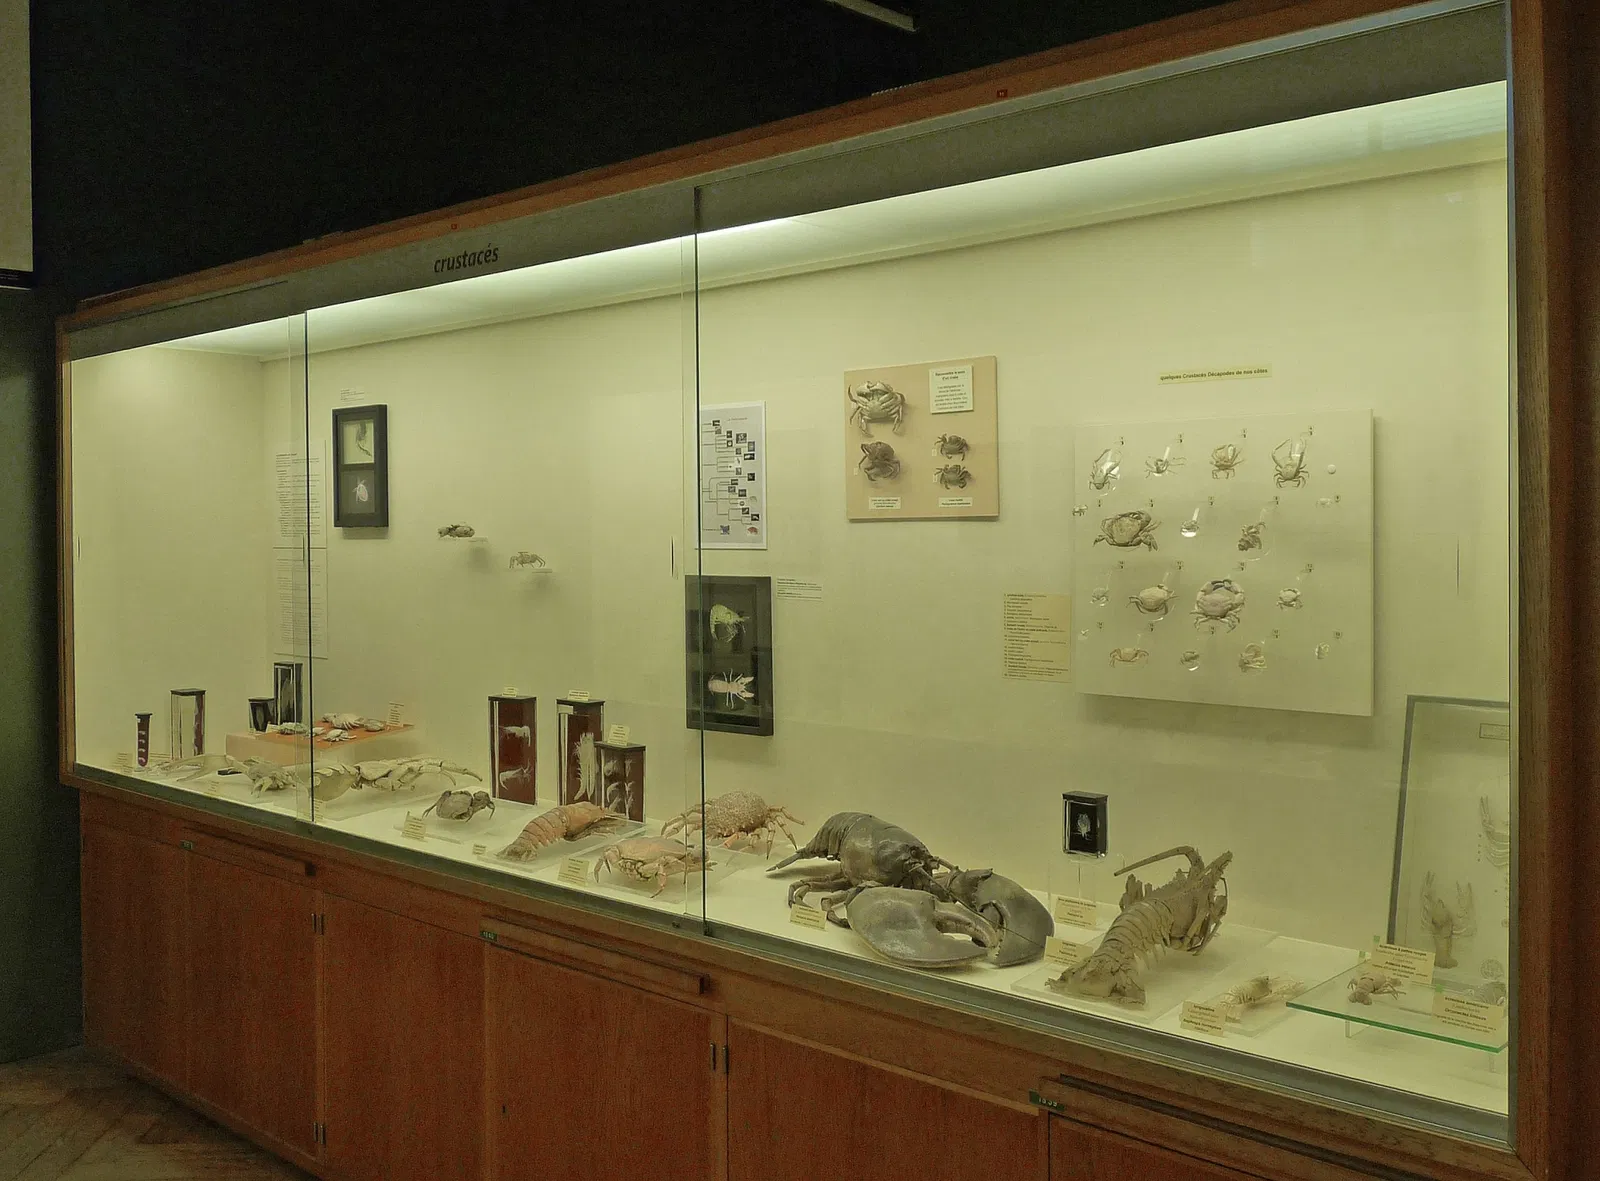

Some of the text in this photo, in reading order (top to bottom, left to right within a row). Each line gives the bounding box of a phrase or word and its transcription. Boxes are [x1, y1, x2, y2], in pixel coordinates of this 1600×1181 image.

[433, 242, 499, 273] crustacés
[1160, 373, 1181, 381] quelques
[1208, 370, 1235, 378] Décapodes
